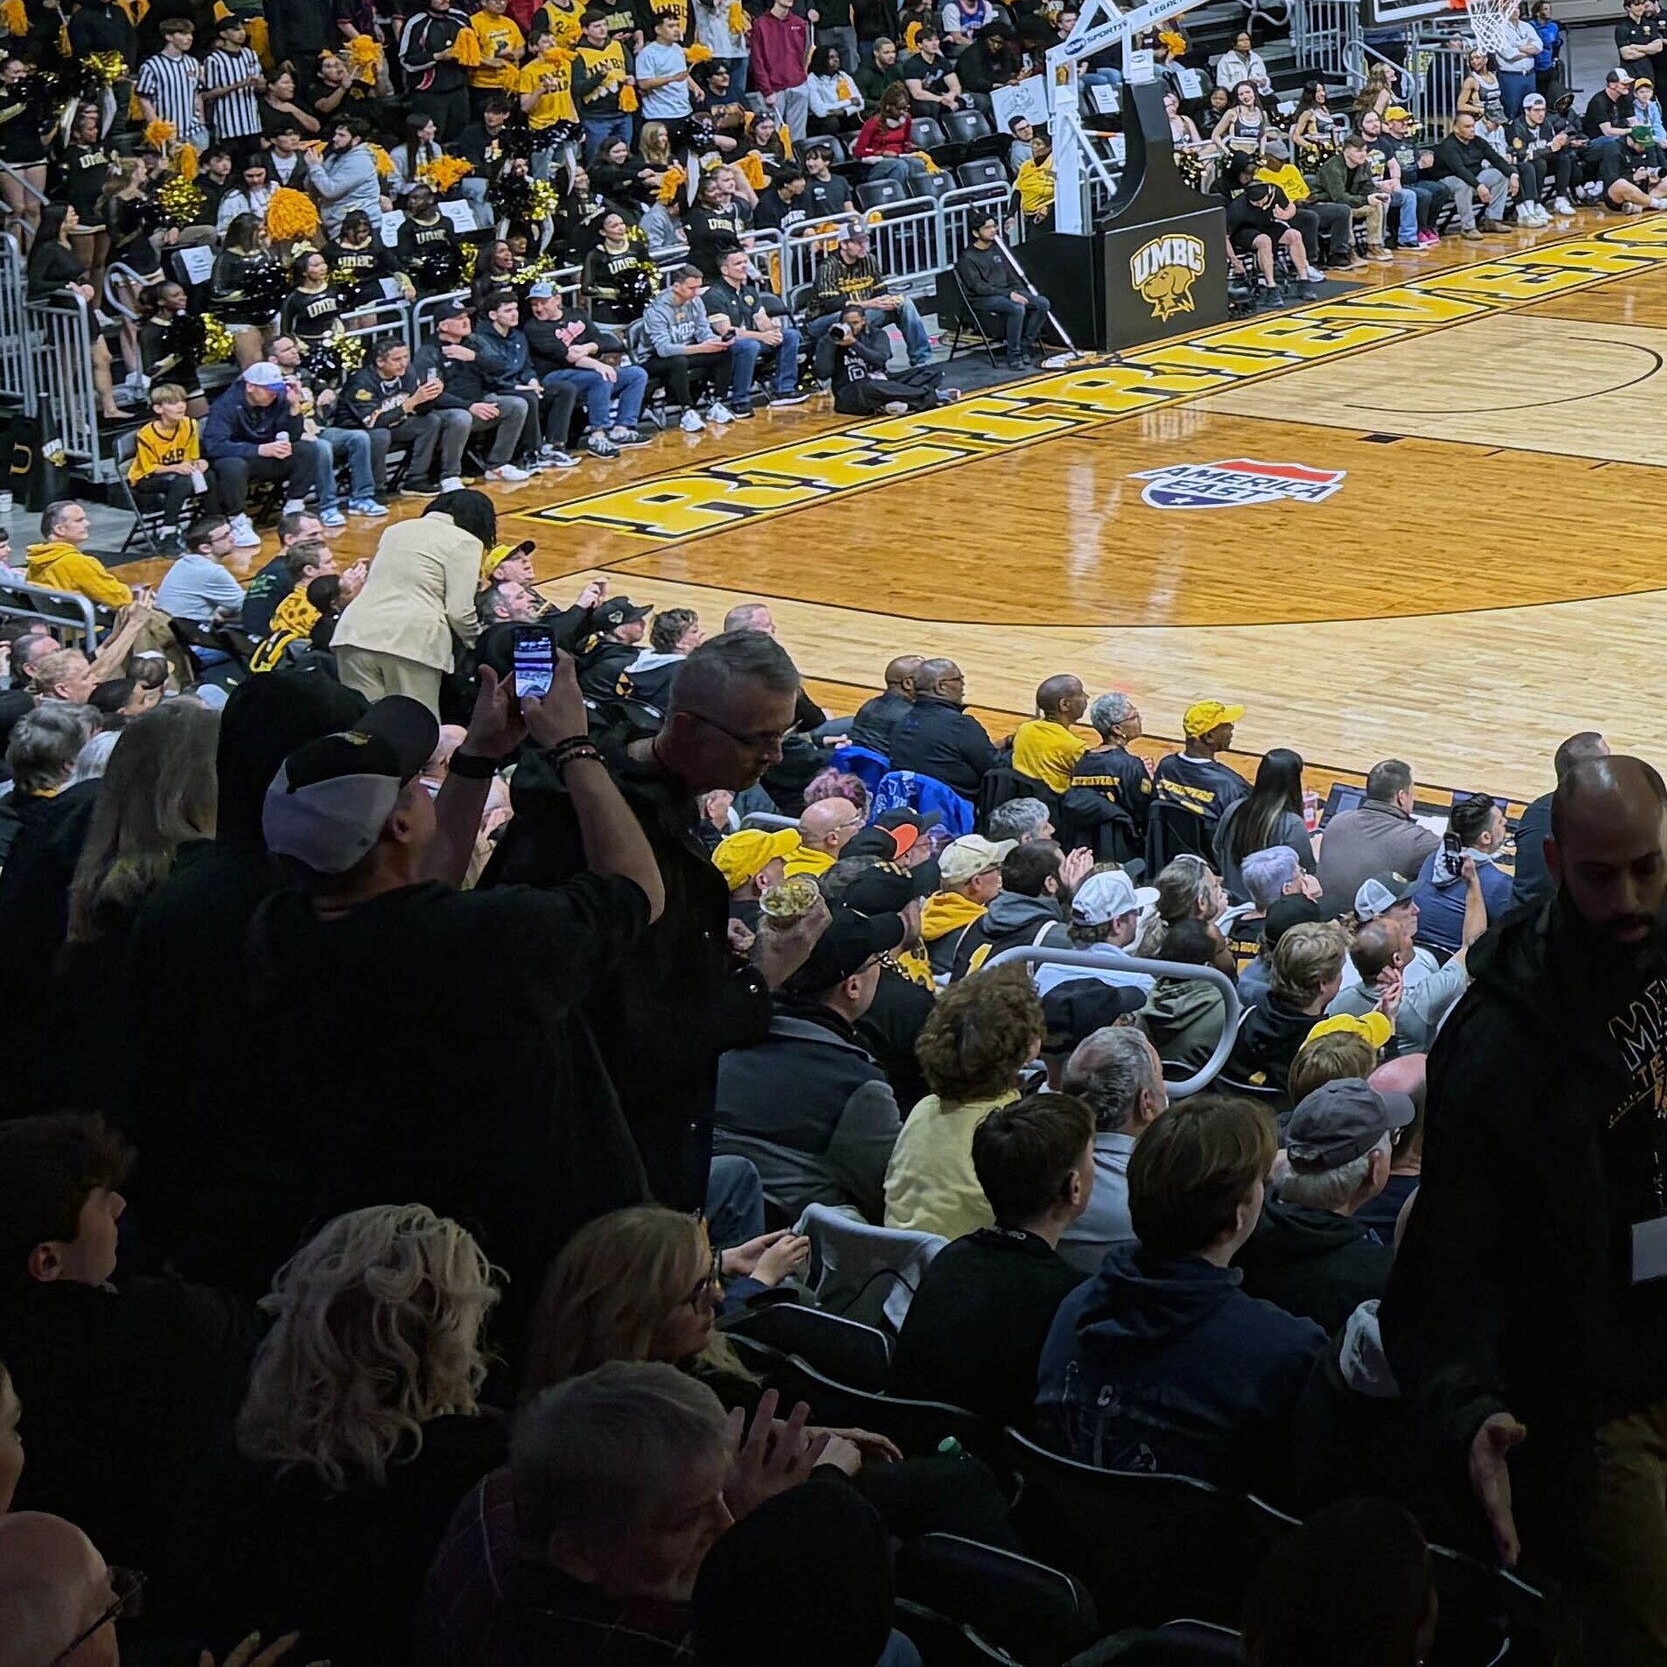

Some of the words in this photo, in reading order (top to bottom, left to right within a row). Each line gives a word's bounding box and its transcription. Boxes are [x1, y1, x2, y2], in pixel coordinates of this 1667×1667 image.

[1086, 22, 1123, 43] SPORTS
[1131, 235, 1205, 287] UMBC
[1144, 466, 1331, 500] AMERICA
[1158, 479, 1274, 500] EAST
